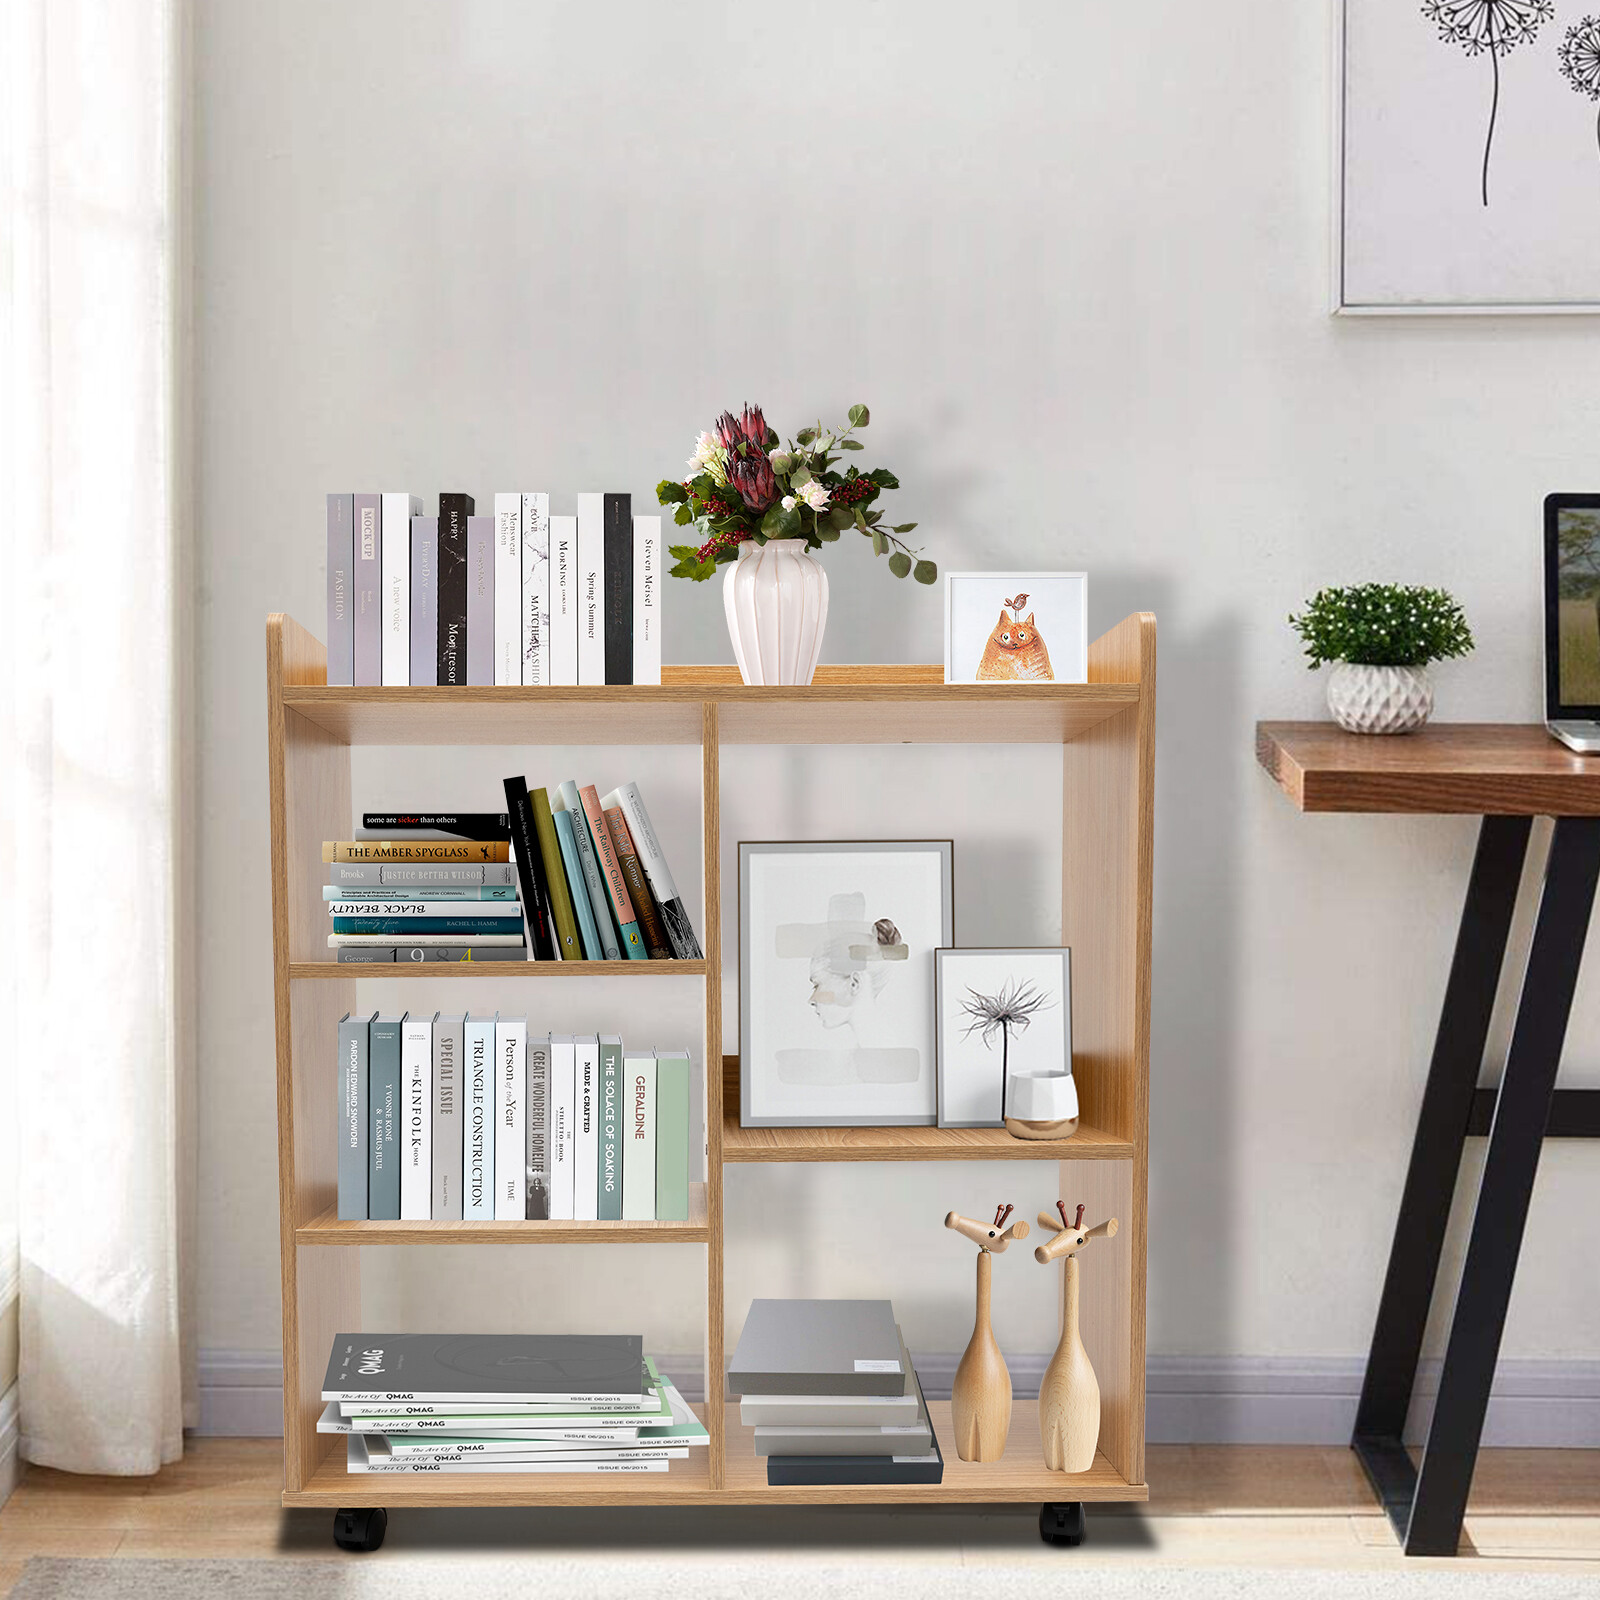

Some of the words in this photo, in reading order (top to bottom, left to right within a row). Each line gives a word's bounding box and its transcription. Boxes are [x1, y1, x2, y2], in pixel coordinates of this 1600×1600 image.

[364, 511, 372, 540] MOCK
[450, 511, 458, 541] HAPPY
[364, 542, 372, 558] UP
[644, 538, 653, 571] Steven
[335, 570, 344, 621] FASHION
[394, 576, 402, 585] A
[586, 572, 596, 600] Spring
[644, 575, 653, 608] Meisel
[394, 609, 402, 632] voice
[448, 623, 459, 647] Mon
[588, 603, 596, 639] Summer
[448, 650, 458, 684] tresor
[572, 808, 589, 853] ARCHITECTURE
[346, 848, 370, 858] THE
[373, 848, 413, 858] AMBER
[415, 848, 468, 858] SPYGLASS
[594, 817, 602, 834] The
[600, 833, 614, 868] Railway
[610, 869, 625, 906] Children
[609, 810, 620, 831] The
[615, 832, 631, 854] Kite
[626, 855, 641, 889] Runner
[637, 890, 650, 914] Khaled
[340, 870, 364, 879] Brooks
[328, 904, 380, 914] BEAUTY
[384, 904, 426, 914] BLACK
[440, 1038, 453, 1081] SPECIAL
[473, 1038, 484, 1104] TRIANGLE
[506, 1038, 516, 1081] Person
[533, 1051, 546, 1079] CREATE
[606, 1056, 614, 1076] THE
[440, 1086, 453, 1115] ISSUE
[506, 1082, 511, 1090] of
[606, 1081, 614, 1121] SOLACE
[411, 1079, 422, 1146] KINFOLK
[506, 1100, 516, 1128] Year
[533, 1082, 546, 1130] WONDERFUL
[635, 1075, 646, 1140] GERALDINE
[606, 1125, 614, 1140] OF
[472, 1106, 484, 1207] CONSTRUCTION
[532, 1134, 544, 1172] HOMELIFE
[605, 1144, 614, 1192] SOAKING
[358, 1349, 386, 1375] QMAG
